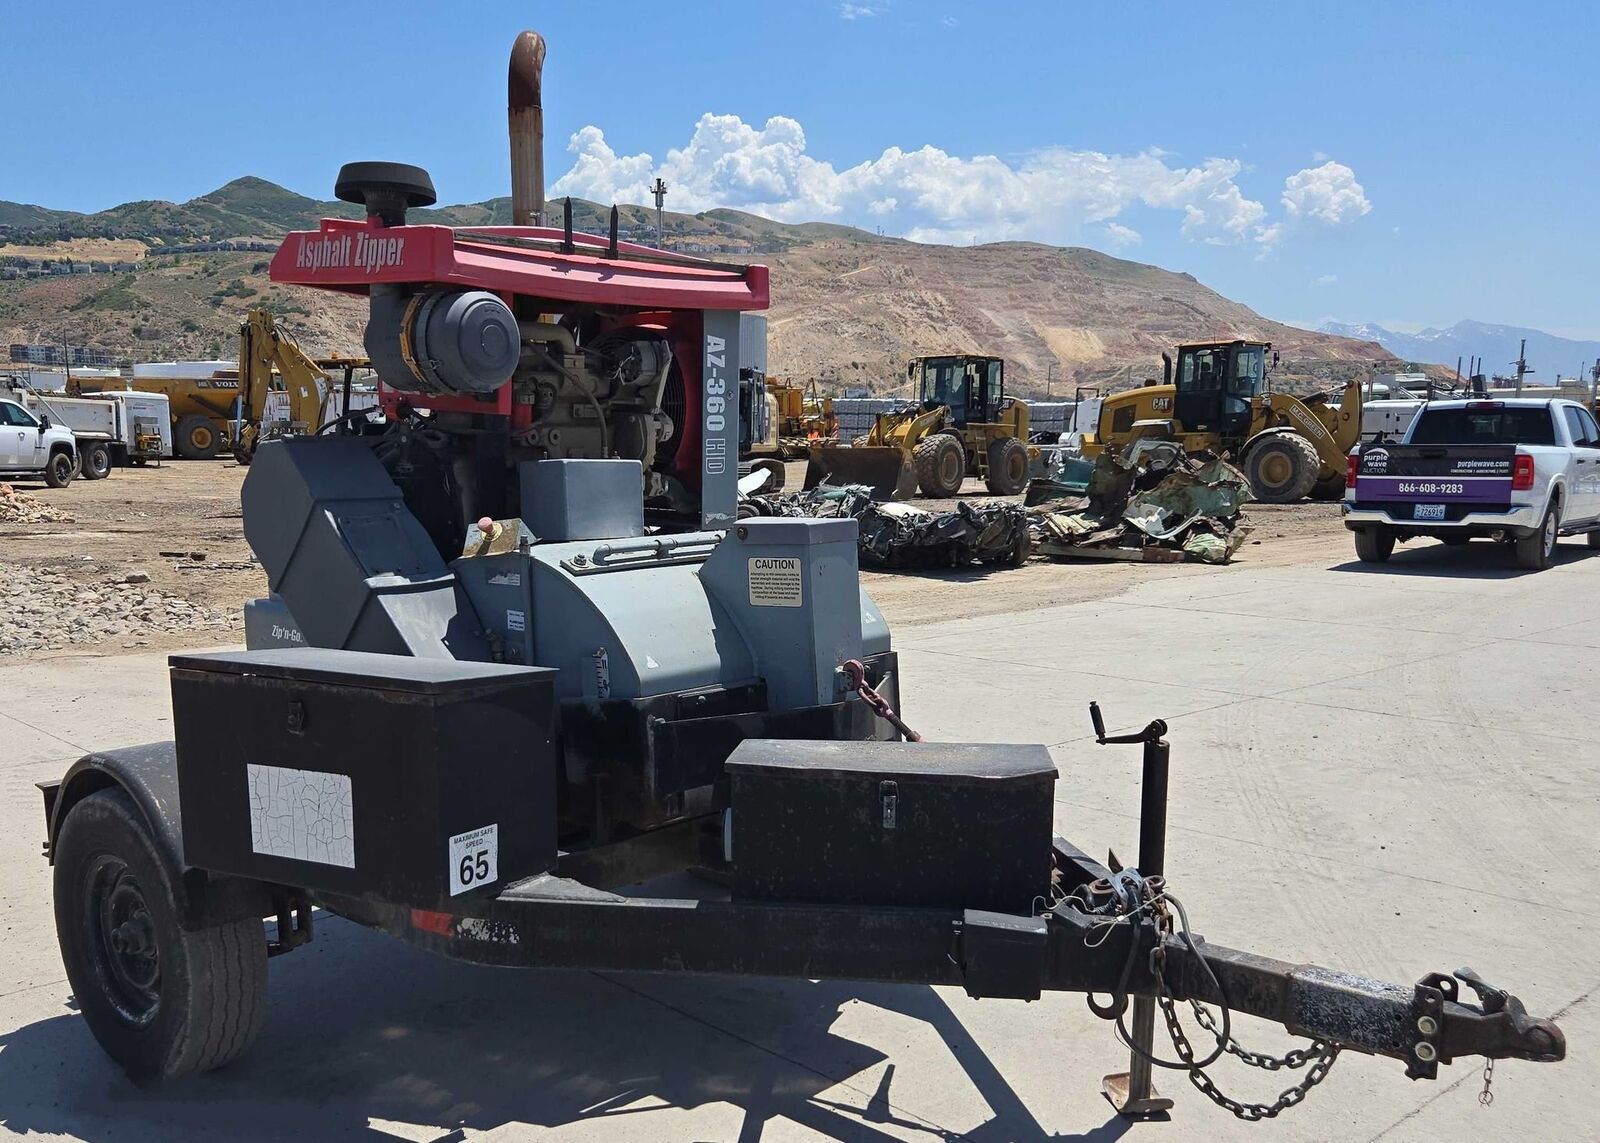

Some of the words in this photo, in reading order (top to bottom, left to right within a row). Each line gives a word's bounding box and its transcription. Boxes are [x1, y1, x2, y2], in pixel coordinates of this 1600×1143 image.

[296, 234, 352, 274] Asphalt
[706, 335, 726, 432] AZ-360
[1152, 397, 1169, 410] CAT
[706, 438, 726, 475] HD
[1363, 453, 1388, 462] purple
[1457, 460, 1509, 468] purplewave.com
[1398, 483, 1463, 494] 866-608-9283
[755, 559, 795, 569] CAUTION
[453, 832, 480, 843] MAXIMUM
[480, 827, 494, 836] SAFE
[465, 838, 484, 849] SPEED
[460, 849, 489, 885] 65
